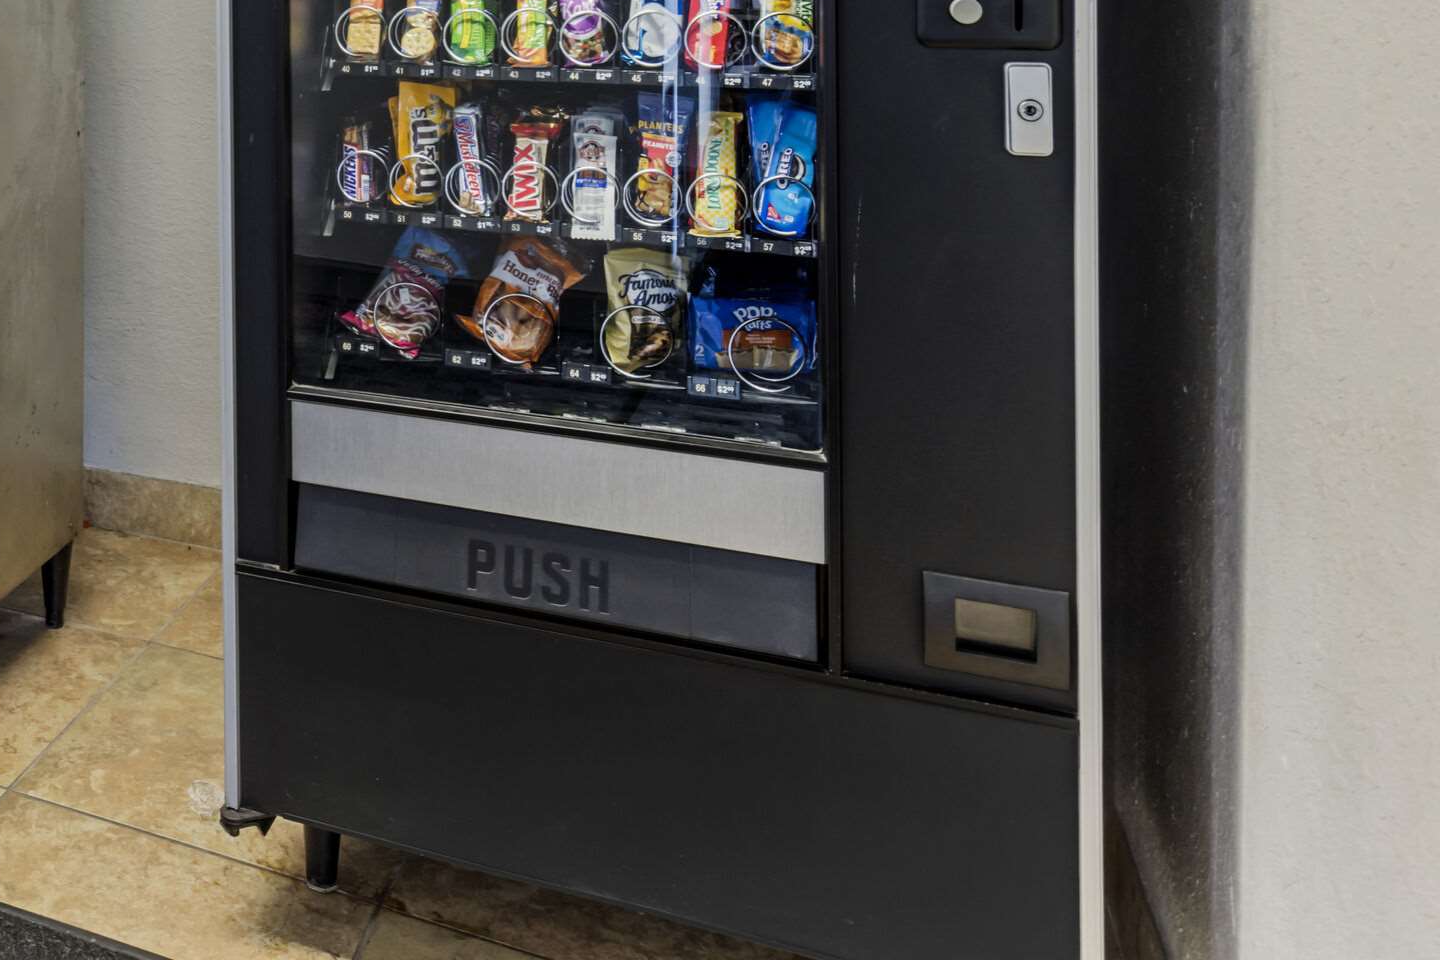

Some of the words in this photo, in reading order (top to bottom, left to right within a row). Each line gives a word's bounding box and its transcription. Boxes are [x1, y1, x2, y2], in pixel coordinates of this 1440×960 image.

[395, 67, 404, 75] 41
[569, 72, 579, 80] 44
[632, 74, 642, 83] 45
[762, 78, 773, 87] 47
[638, 120, 684, 134] PLANTERS
[343, 146, 357, 199] NICKERS
[776, 147, 793, 190] OREO
[513, 143, 539, 210] TWIX
[343, 211, 352, 219] 50
[397, 215, 406, 223] 51
[511, 224, 521, 232] 53
[763, 242, 773, 251] 57
[618, 269, 677, 298] Famous
[633, 289, 677, 306] Amos
[695, 344, 705, 356] 2
[569, 369, 579, 378] 64
[466, 539, 611, 615] PUSH
